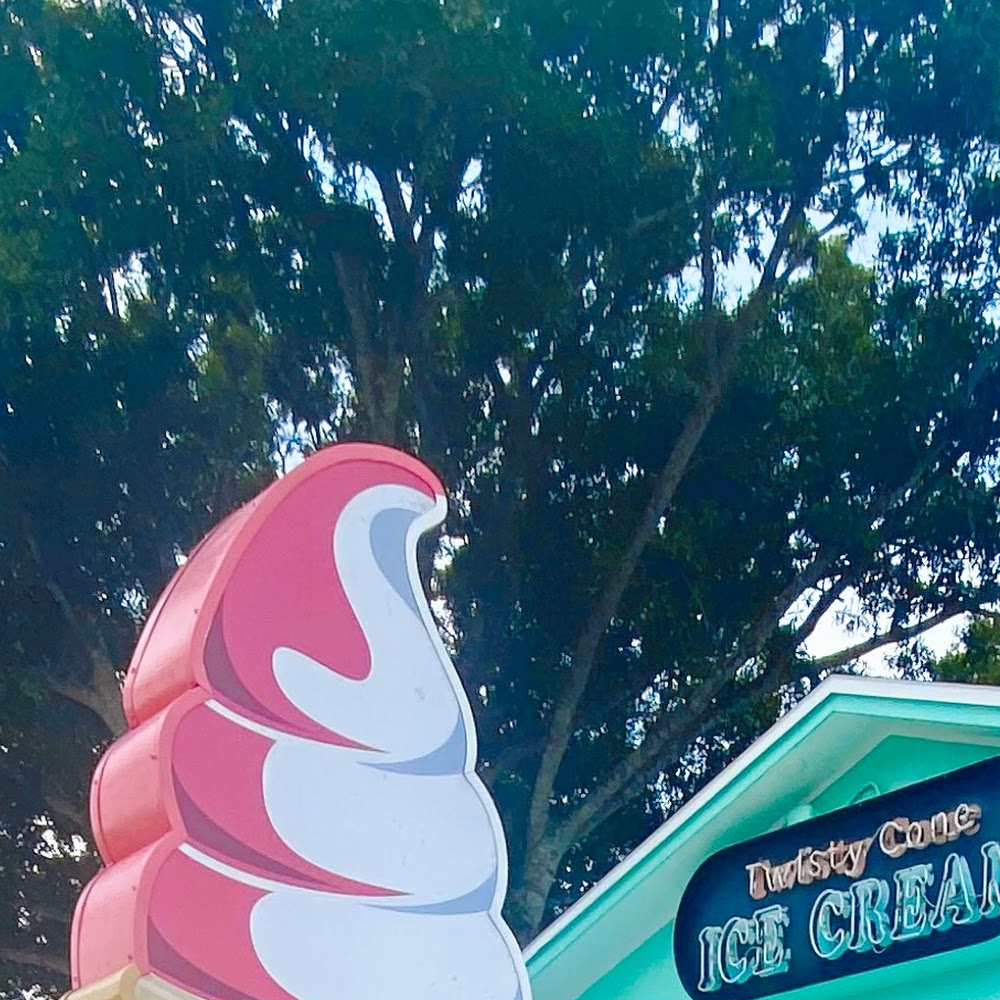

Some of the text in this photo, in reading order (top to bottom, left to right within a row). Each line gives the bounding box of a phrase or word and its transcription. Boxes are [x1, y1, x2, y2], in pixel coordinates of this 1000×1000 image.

[745, 803, 982, 899] Twisty Cone
[697, 904, 791, 992] ICE
